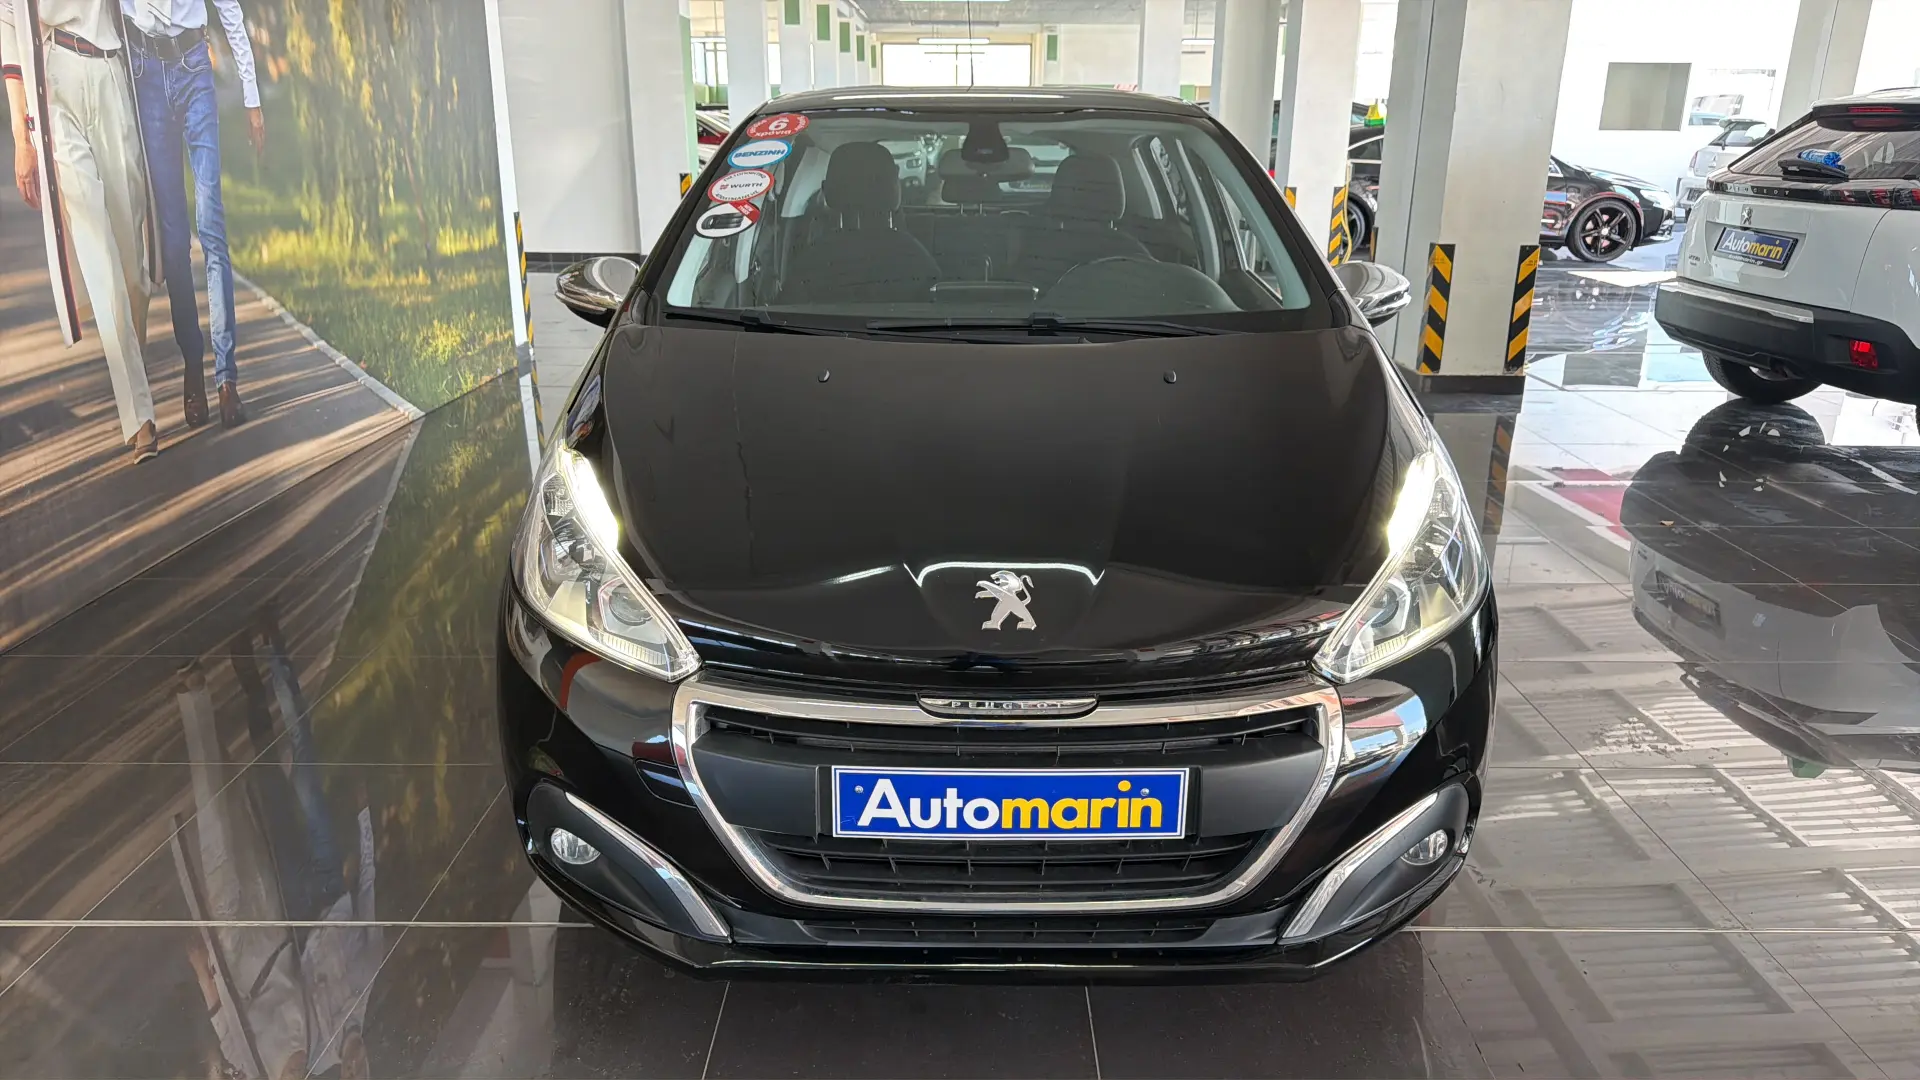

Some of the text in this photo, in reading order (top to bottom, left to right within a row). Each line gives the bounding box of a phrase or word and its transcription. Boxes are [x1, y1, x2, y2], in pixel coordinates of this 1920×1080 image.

[768, 116, 790, 131] 6
[1728, 185, 1790, 195] PEUGEOT
[1722, 232, 1783, 259] Automarin
[951, 700, 1064, 710] PEUGEOT
[857, 778, 1163, 830] Automarin
